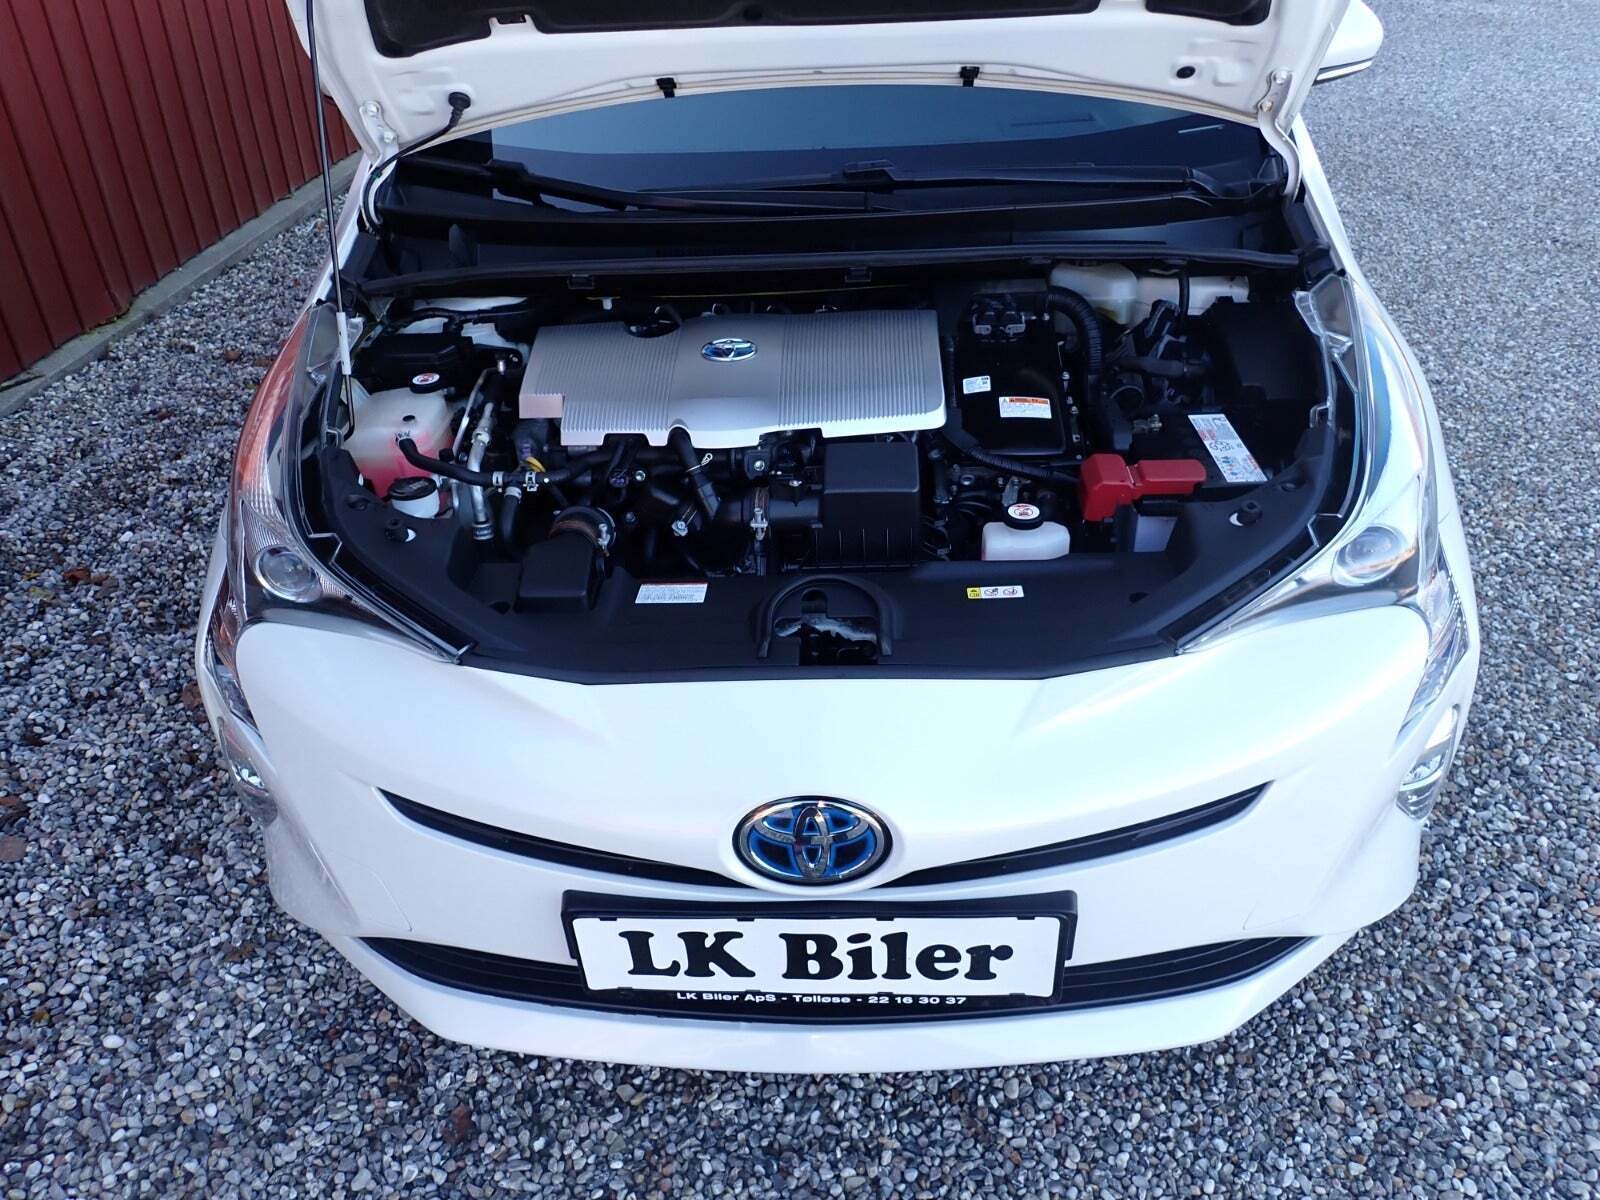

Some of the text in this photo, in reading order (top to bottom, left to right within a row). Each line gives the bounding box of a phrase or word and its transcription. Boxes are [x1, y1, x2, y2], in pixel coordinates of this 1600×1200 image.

[619, 931, 1013, 980] LK Biler
[676, 992, 698, 1000] LK
[702, 992, 740, 1001] Biler
[744, 993, 777, 1003] ApS
[868, 996, 890, 1004] 22
[894, 996, 913, 1004] 16
[918, 996, 941, 1005] 30
[945, 996, 967, 1005] 37
